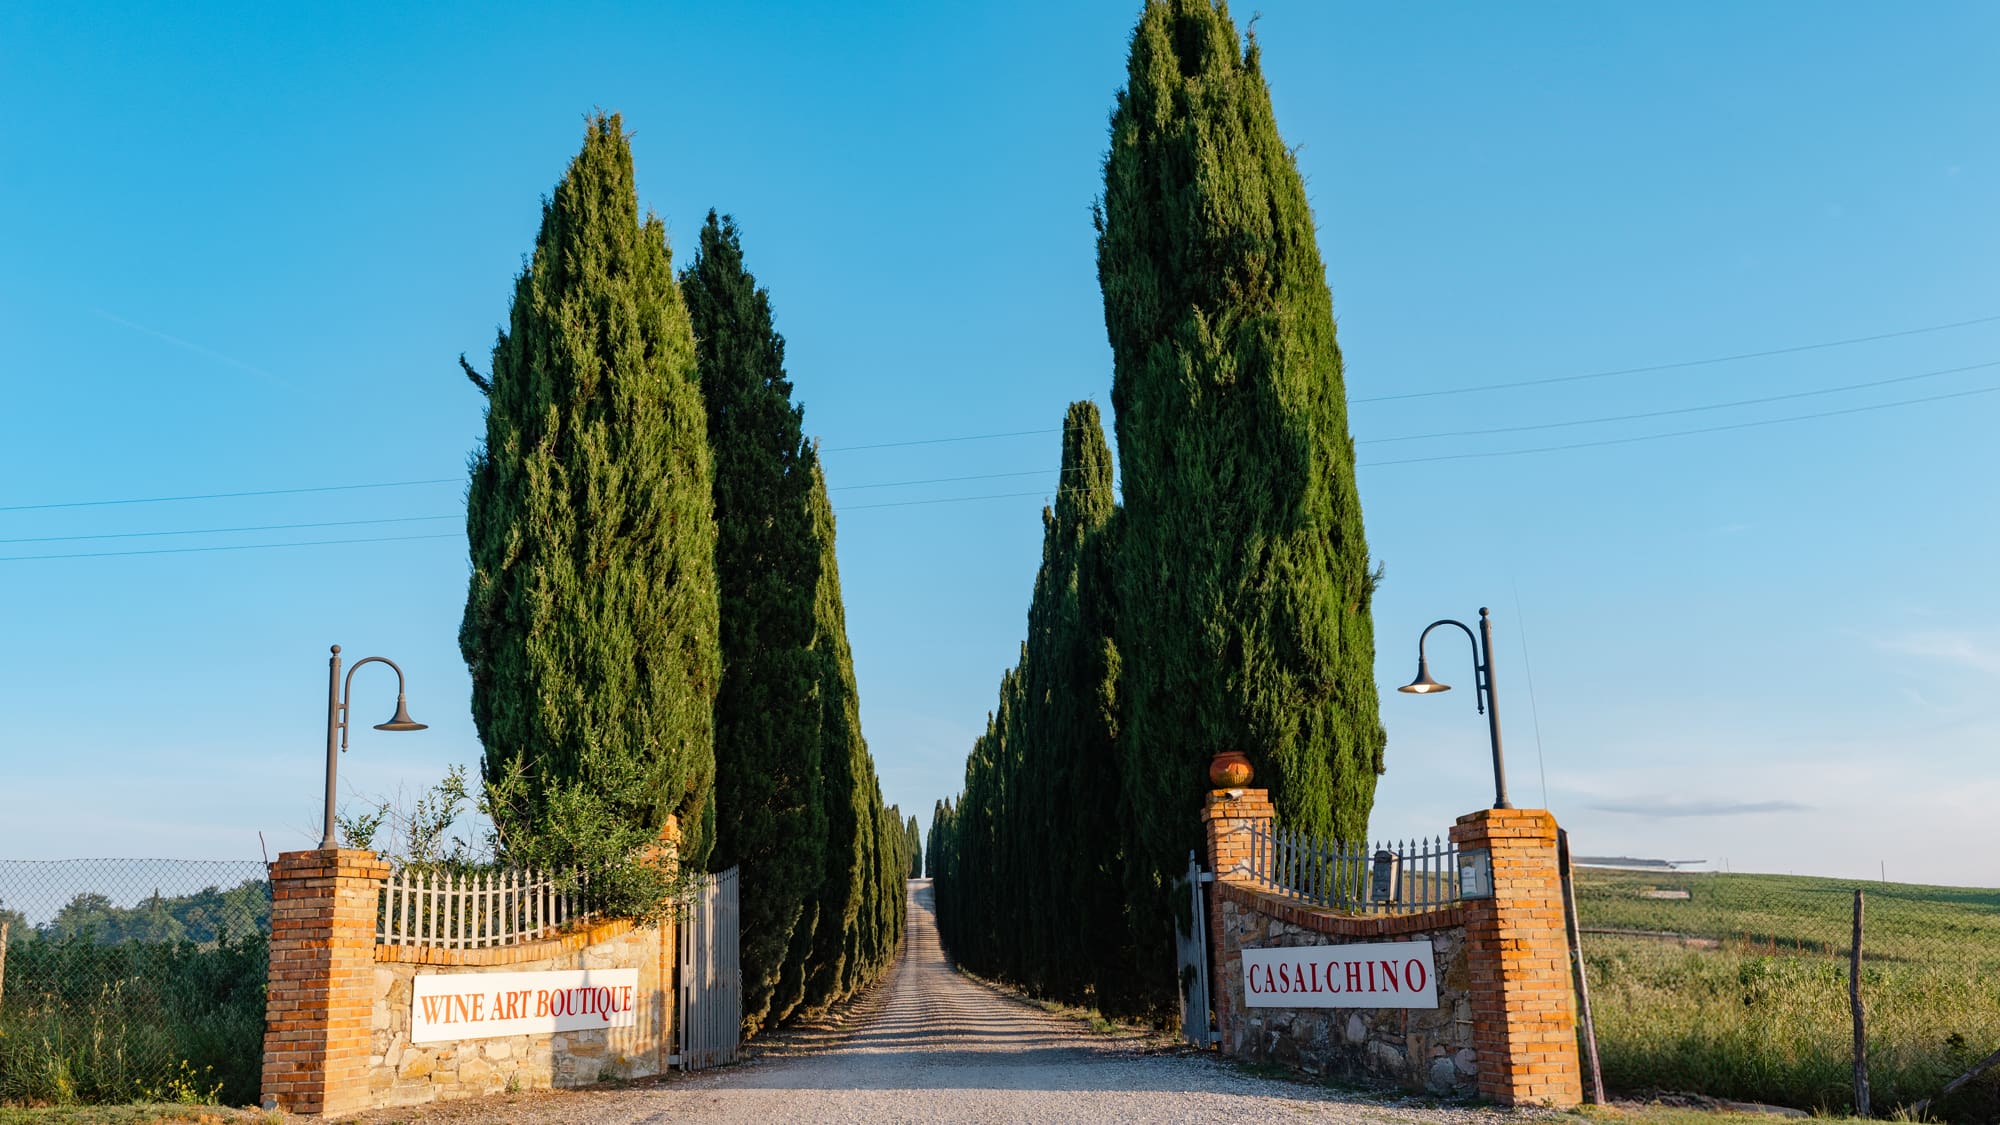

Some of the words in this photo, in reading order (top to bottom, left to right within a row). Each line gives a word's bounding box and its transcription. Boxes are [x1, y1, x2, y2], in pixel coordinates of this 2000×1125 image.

[1249, 958, 1427, 993] CASALCHINO
[421, 993, 484, 1025] WINE
[490, 990, 532, 1021] ART
[535, 985, 632, 1021] BOUTIQUE
